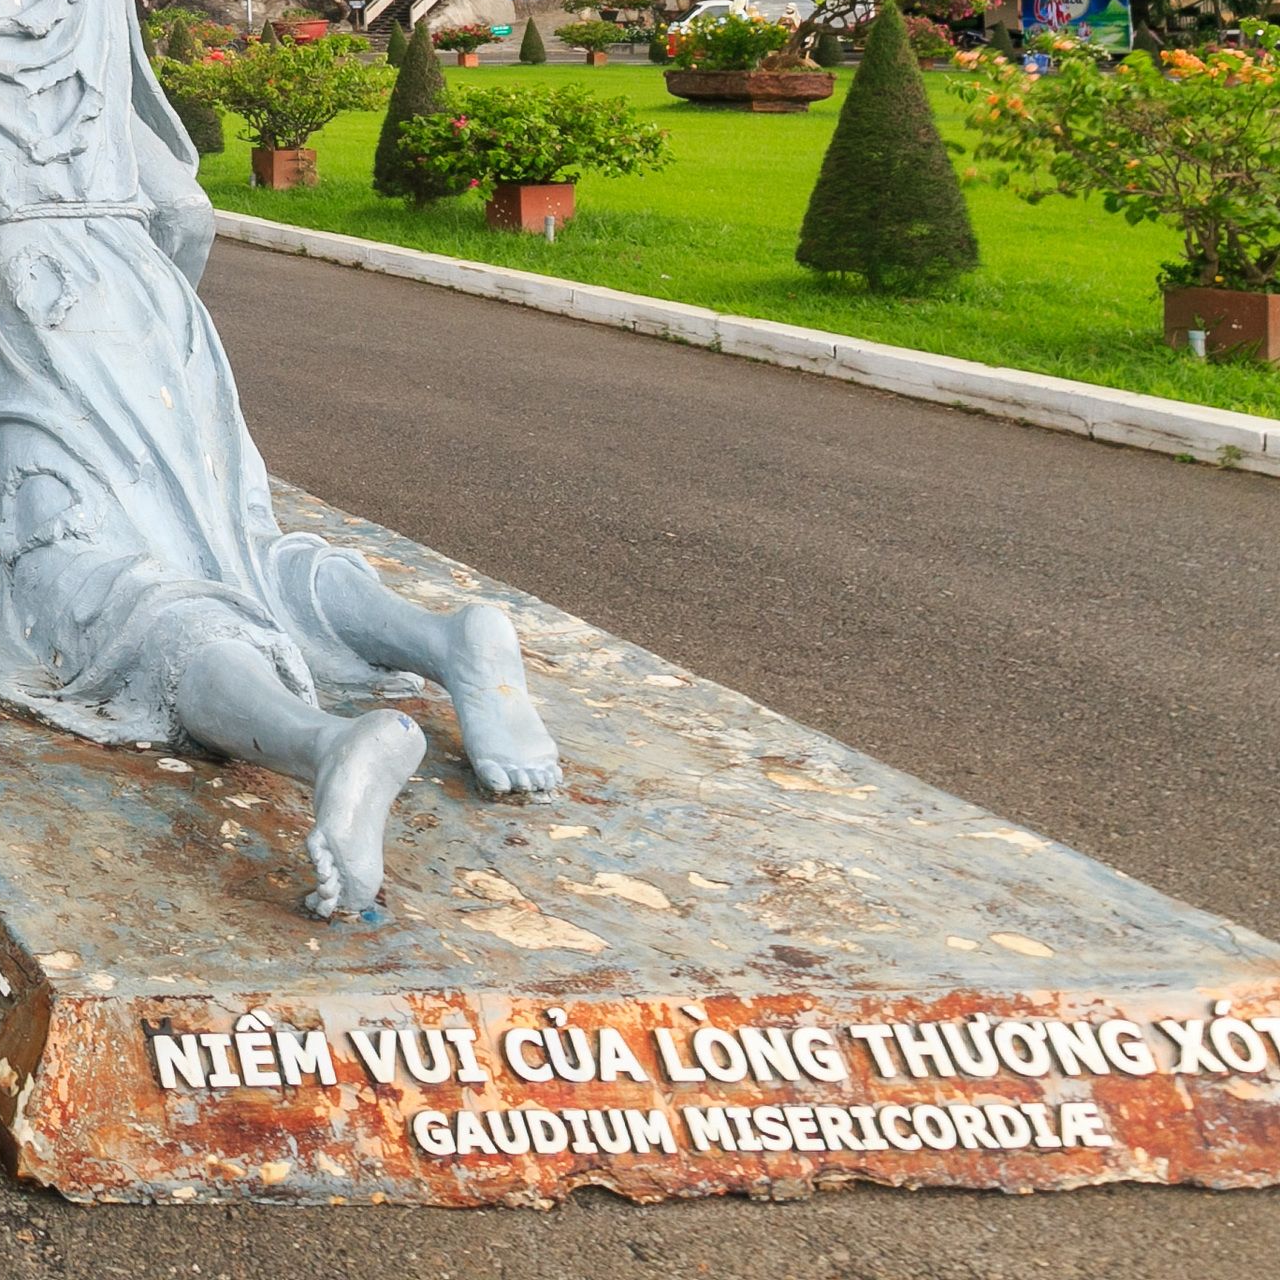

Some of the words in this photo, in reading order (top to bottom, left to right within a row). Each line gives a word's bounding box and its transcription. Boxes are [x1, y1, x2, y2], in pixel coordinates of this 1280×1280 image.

[349, 1026, 488, 1084] VUI
[505, 1007, 650, 1083] CỦA
[654, 1005, 848, 1082] LÒNG
[850, 1012, 1156, 1078] THƯƠNG
[413, 1108, 677, 1155] GAUDIUM
[684, 1102, 1113, 1152] MISERICORDIÆ
